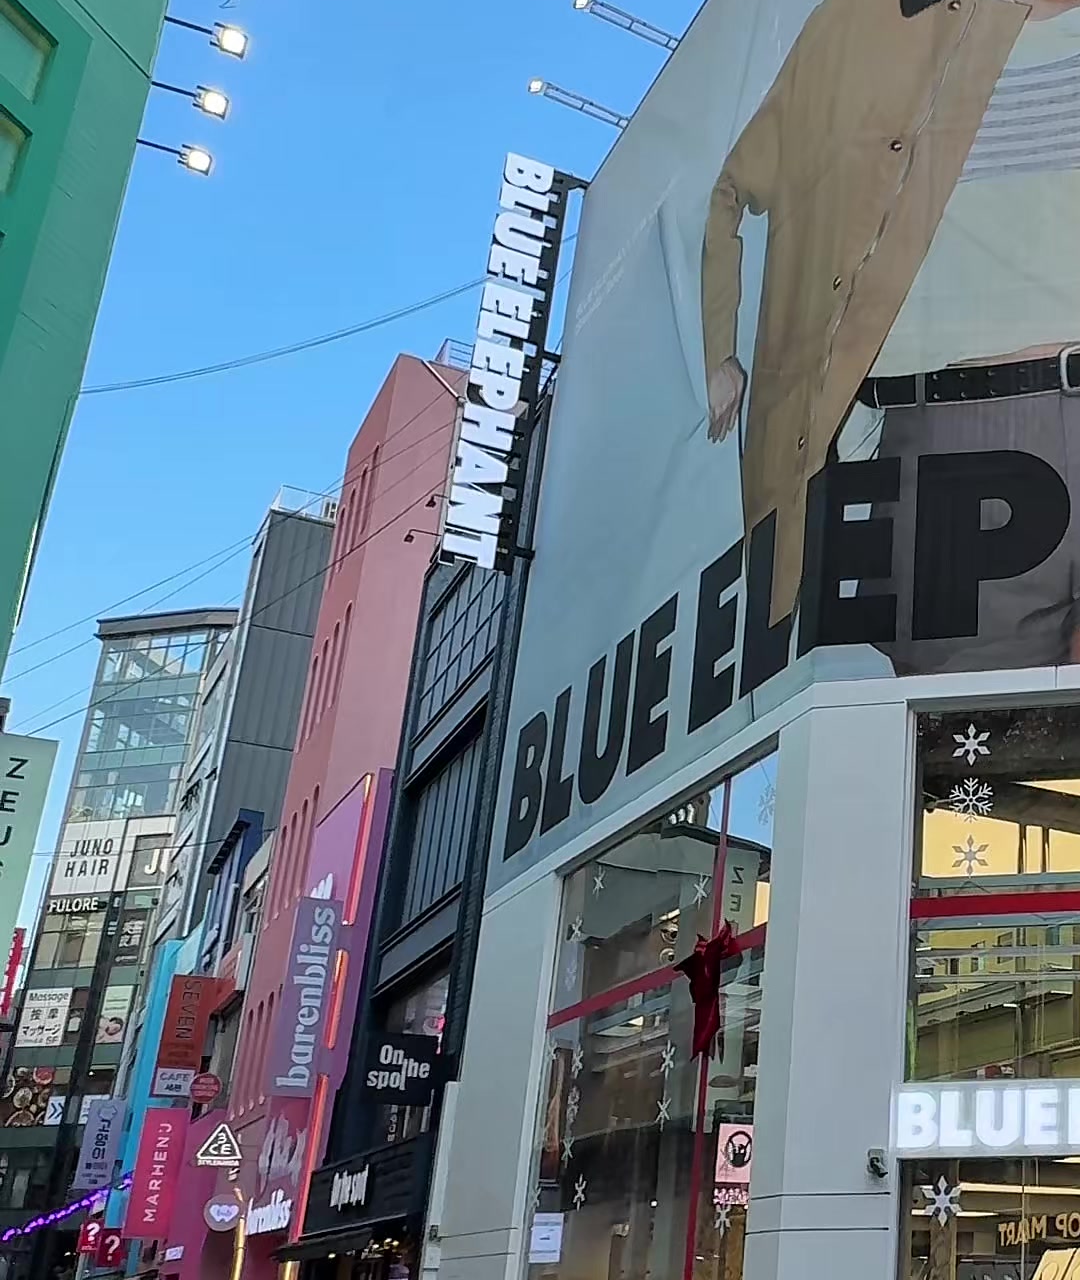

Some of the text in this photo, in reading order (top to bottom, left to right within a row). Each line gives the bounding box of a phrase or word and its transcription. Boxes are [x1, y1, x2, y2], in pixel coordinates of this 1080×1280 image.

[438, 151, 556, 571] BLUE ELEPHANT
[504, 592, 680, 862] BLUE
[69, 839, 113, 857] JUNO
[64, 858, 110, 878] HAIR
[49, 896, 99, 913] FULORE
[276, 906, 335, 1089] barenbliss
[379, 1044, 405, 1066] On
[160, 1072, 191, 1081] CAFE
